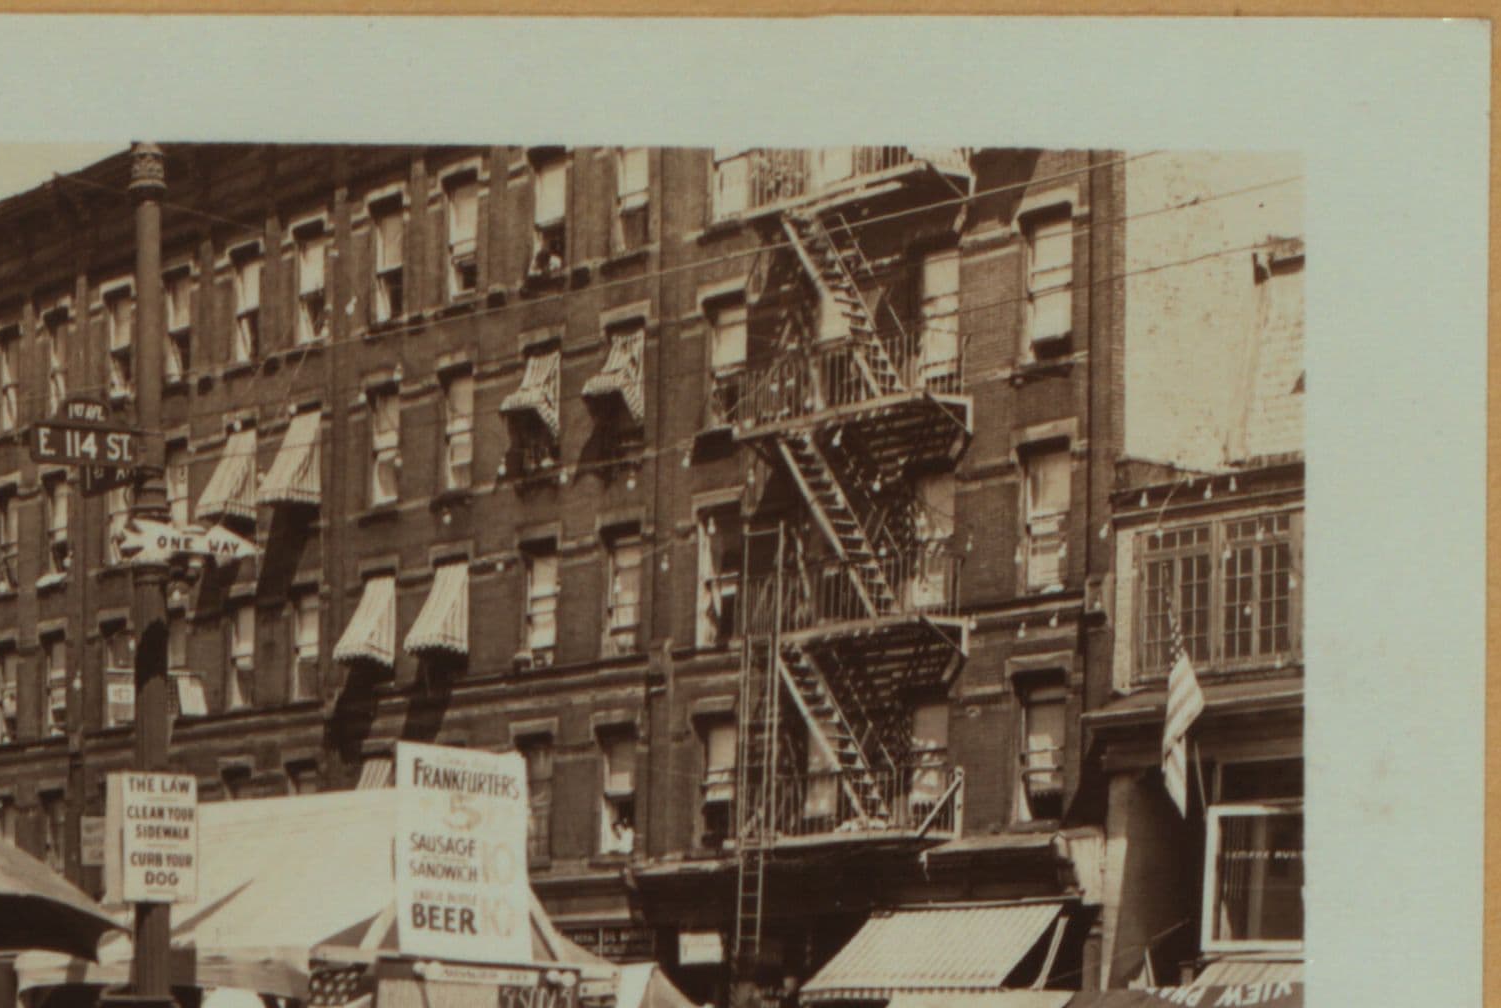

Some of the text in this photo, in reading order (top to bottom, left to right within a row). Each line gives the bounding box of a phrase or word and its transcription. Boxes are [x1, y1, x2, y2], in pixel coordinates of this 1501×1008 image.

[65, 430, 98, 460] 114
[156, 535, 241, 554] ONE WAY
[129, 776, 191, 794] THE LAW
[413, 757, 520, 801] FRANKFURTERS
[127, 805, 195, 821] CLEAN YOUR
[135, 824, 190, 840] SIDEWALK
[409, 831, 477, 858] SAUSAGE
[130, 852, 193, 868] CURB YOUR
[409, 859, 478, 882] SANDWICH
[144, 870, 179, 886] DOG
[411, 902, 478, 936] BEER
[1212, 982, 1293, 1008] VIEW
